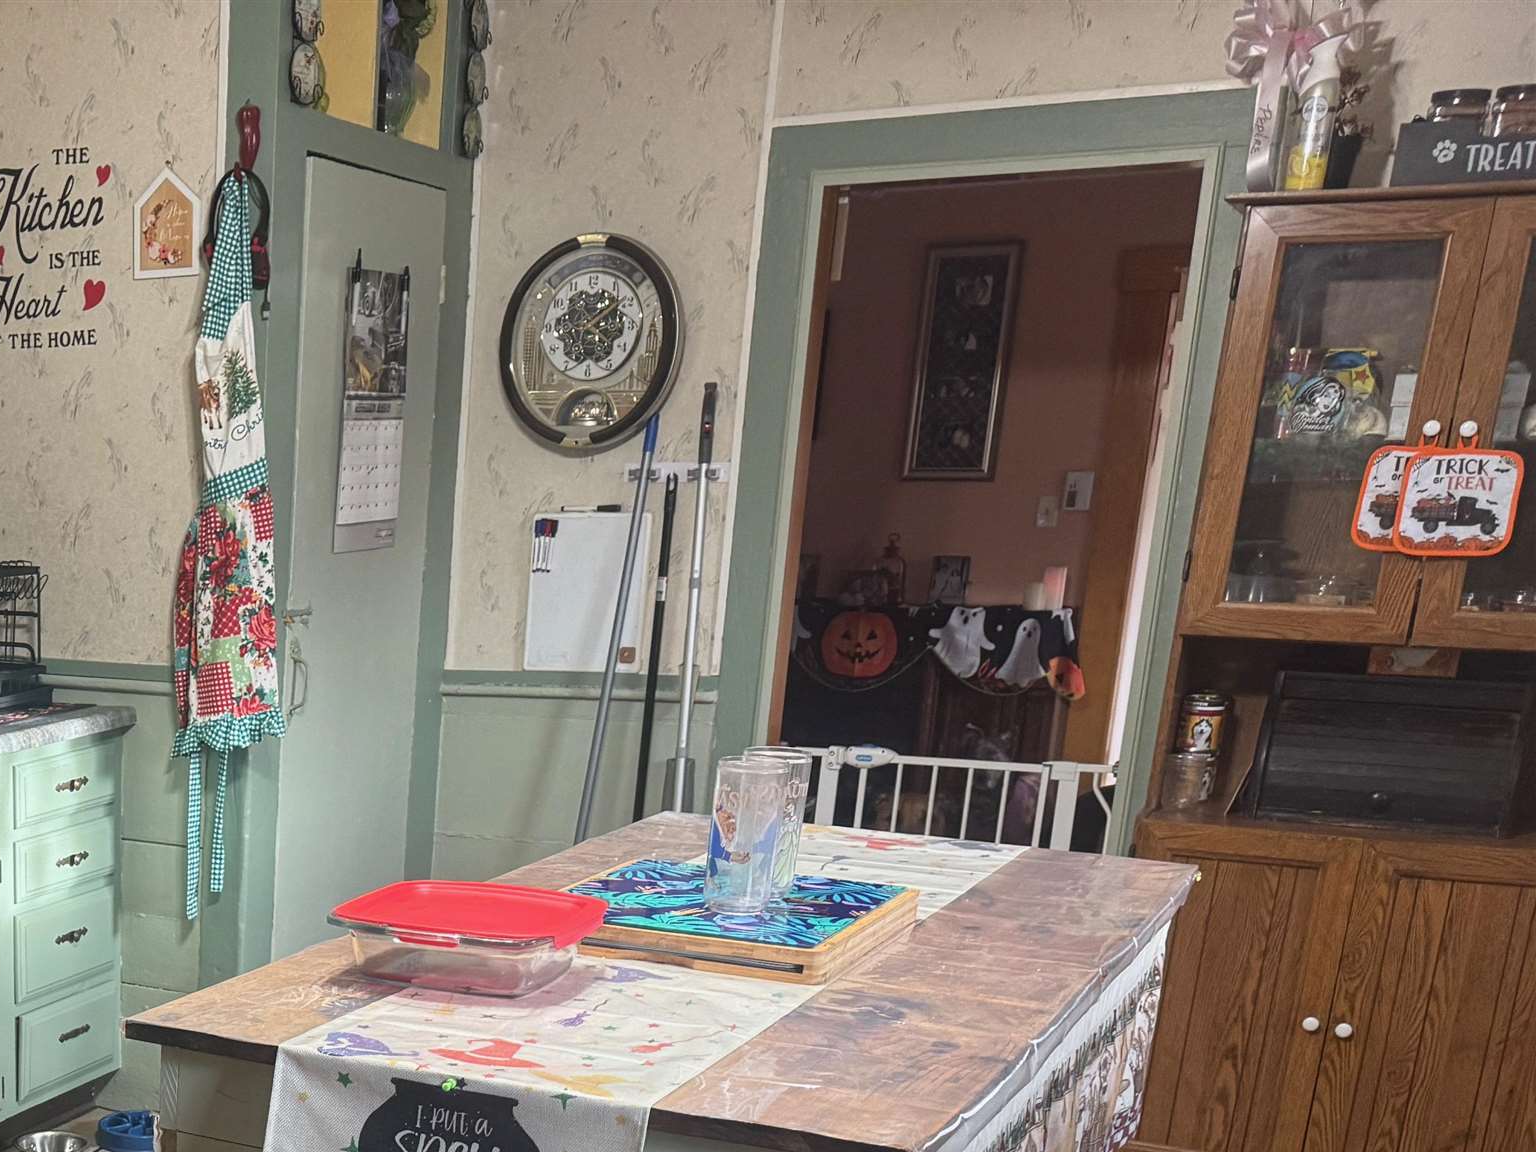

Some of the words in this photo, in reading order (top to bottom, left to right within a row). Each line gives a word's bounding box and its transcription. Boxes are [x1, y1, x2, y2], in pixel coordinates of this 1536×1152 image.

[52, 147, 90, 165] THE
[49, 252, 64, 270] IS
[65, 249, 102, 267] THE
[8, 333, 44, 350] THE
[47, 328, 98, 349] HOME
[1435, 458, 1490, 476] TRICK
[1447, 476, 1497, 492] TREAT
[415, 1104, 423, 1129] I
[474, 1117, 493, 1138] a
